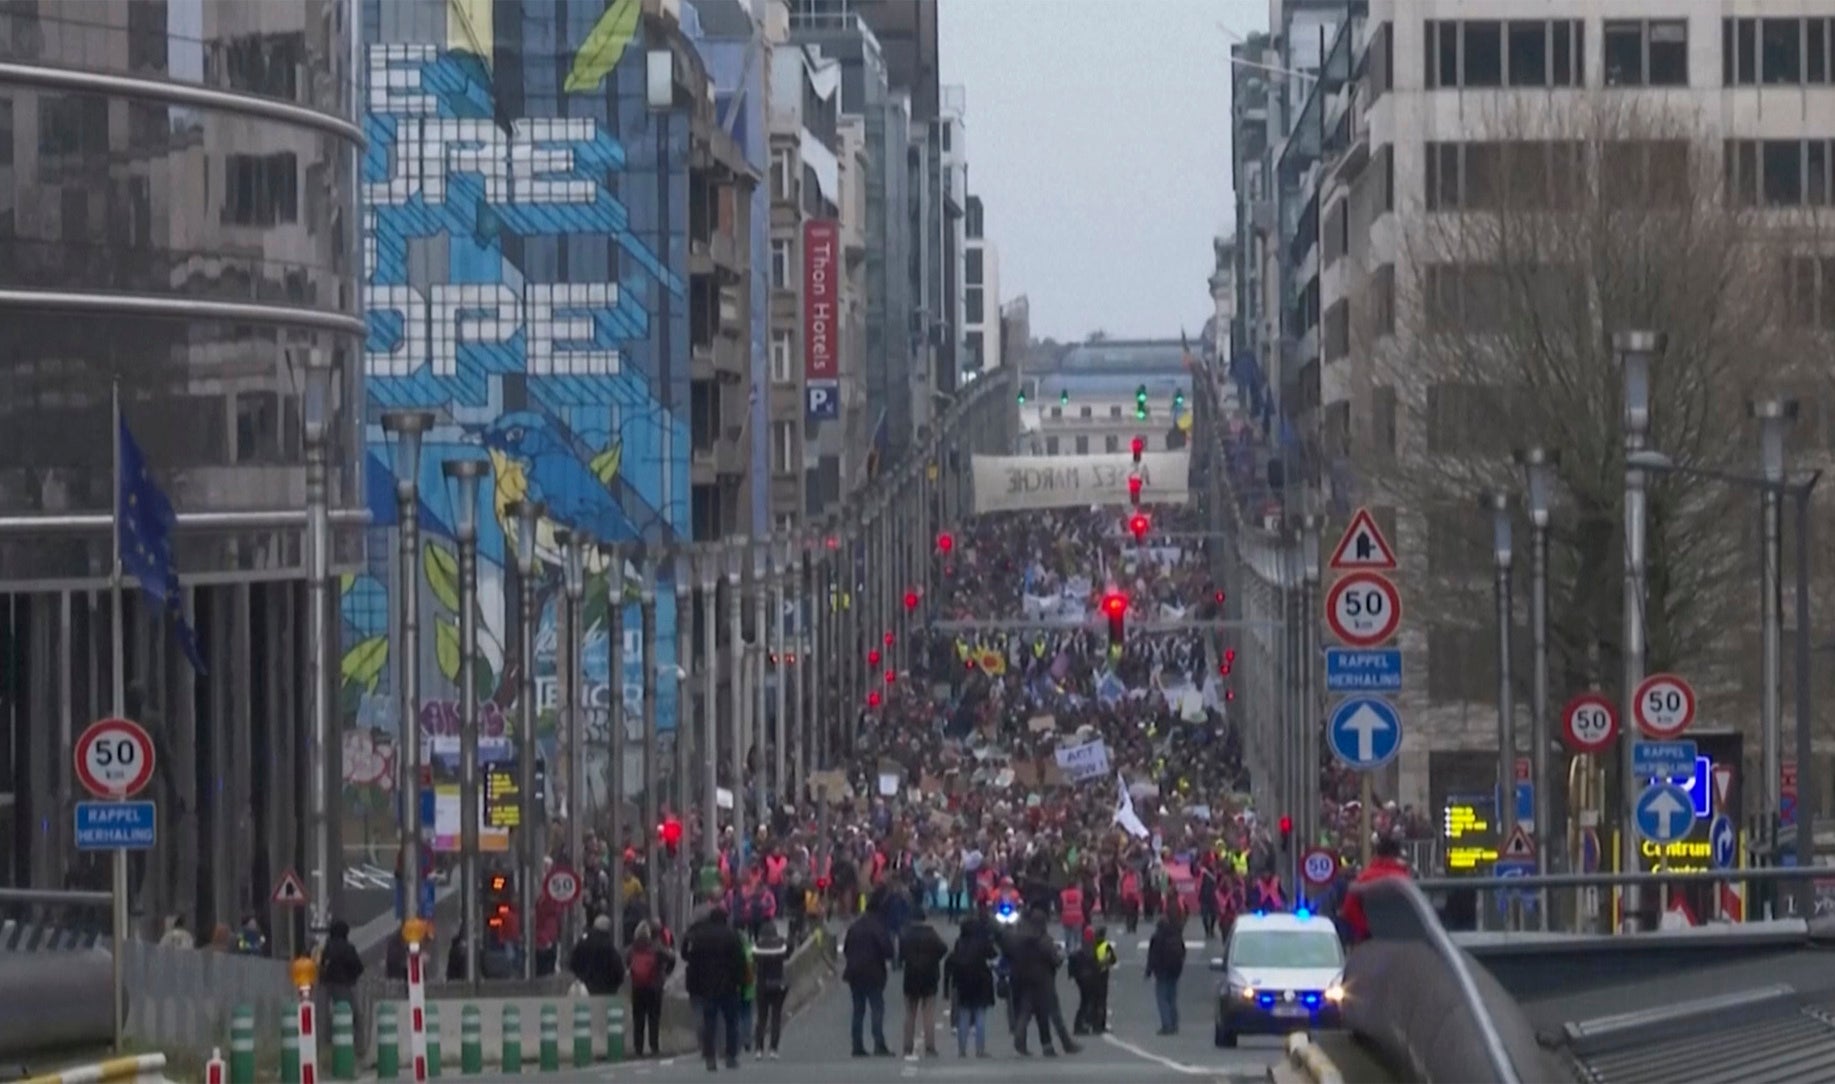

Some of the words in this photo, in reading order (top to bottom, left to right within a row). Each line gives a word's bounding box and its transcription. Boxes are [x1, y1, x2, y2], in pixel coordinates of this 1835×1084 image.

[813, 242, 830, 295] Thon
[813, 303, 830, 370] Hotels
[810, 389, 827, 412] P
[1346, 591, 1382, 616] 50
[1339, 653, 1388, 668] RAPPEL
[1328, 673, 1400, 686] HERHALING
[1649, 691, 1681, 713] 50
[1577, 709, 1606, 730] 50
[96, 740, 134, 765] 50
[1642, 746, 1685, 759] RAPPEL
[88, 807, 140, 823] RAPPEL
[78, 828, 154, 843] HERHALING
[1308, 858, 1330, 874] 50
[552, 878, 573, 892] 50
